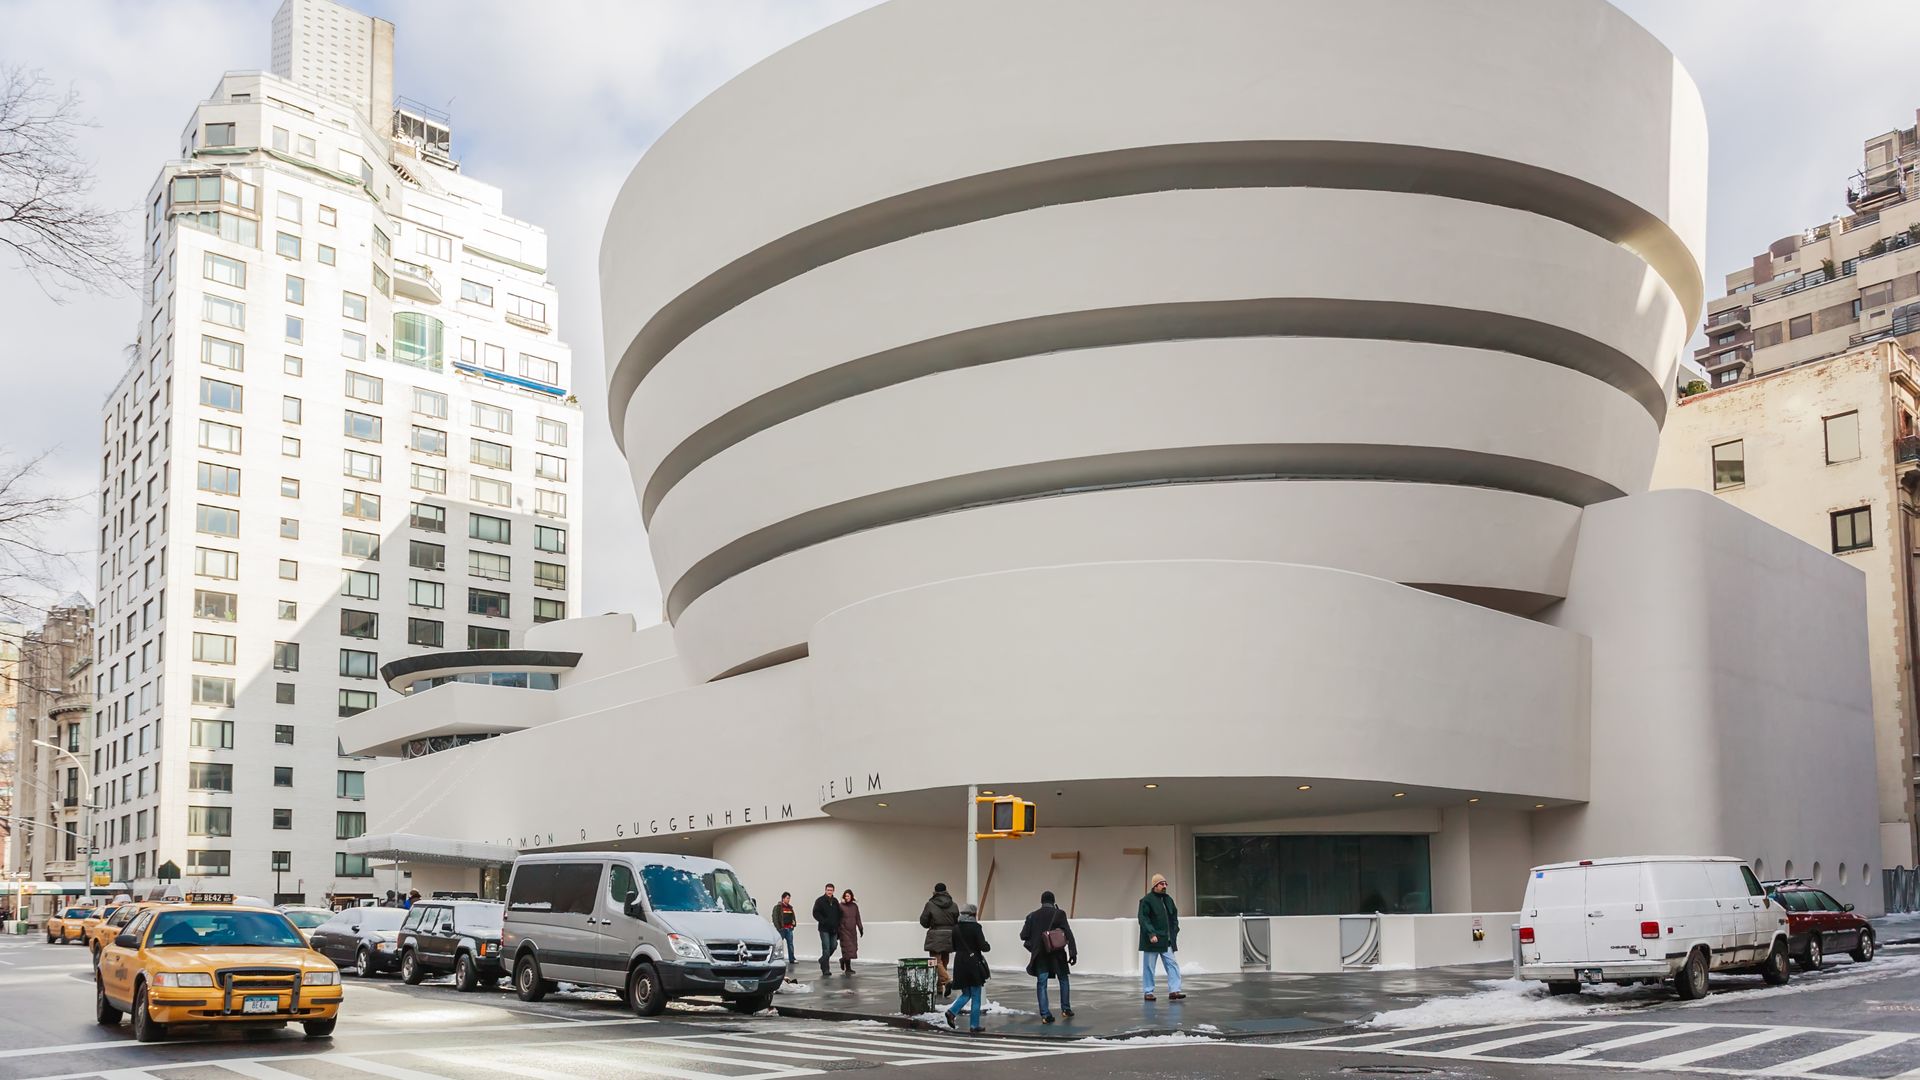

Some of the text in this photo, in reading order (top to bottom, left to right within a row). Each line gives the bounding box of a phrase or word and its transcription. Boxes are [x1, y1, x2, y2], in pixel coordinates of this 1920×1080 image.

[580, 828, 587, 841] R
[616, 803, 793, 837] GUGGENHEIM
[203, 894, 222, 902] 8E42
